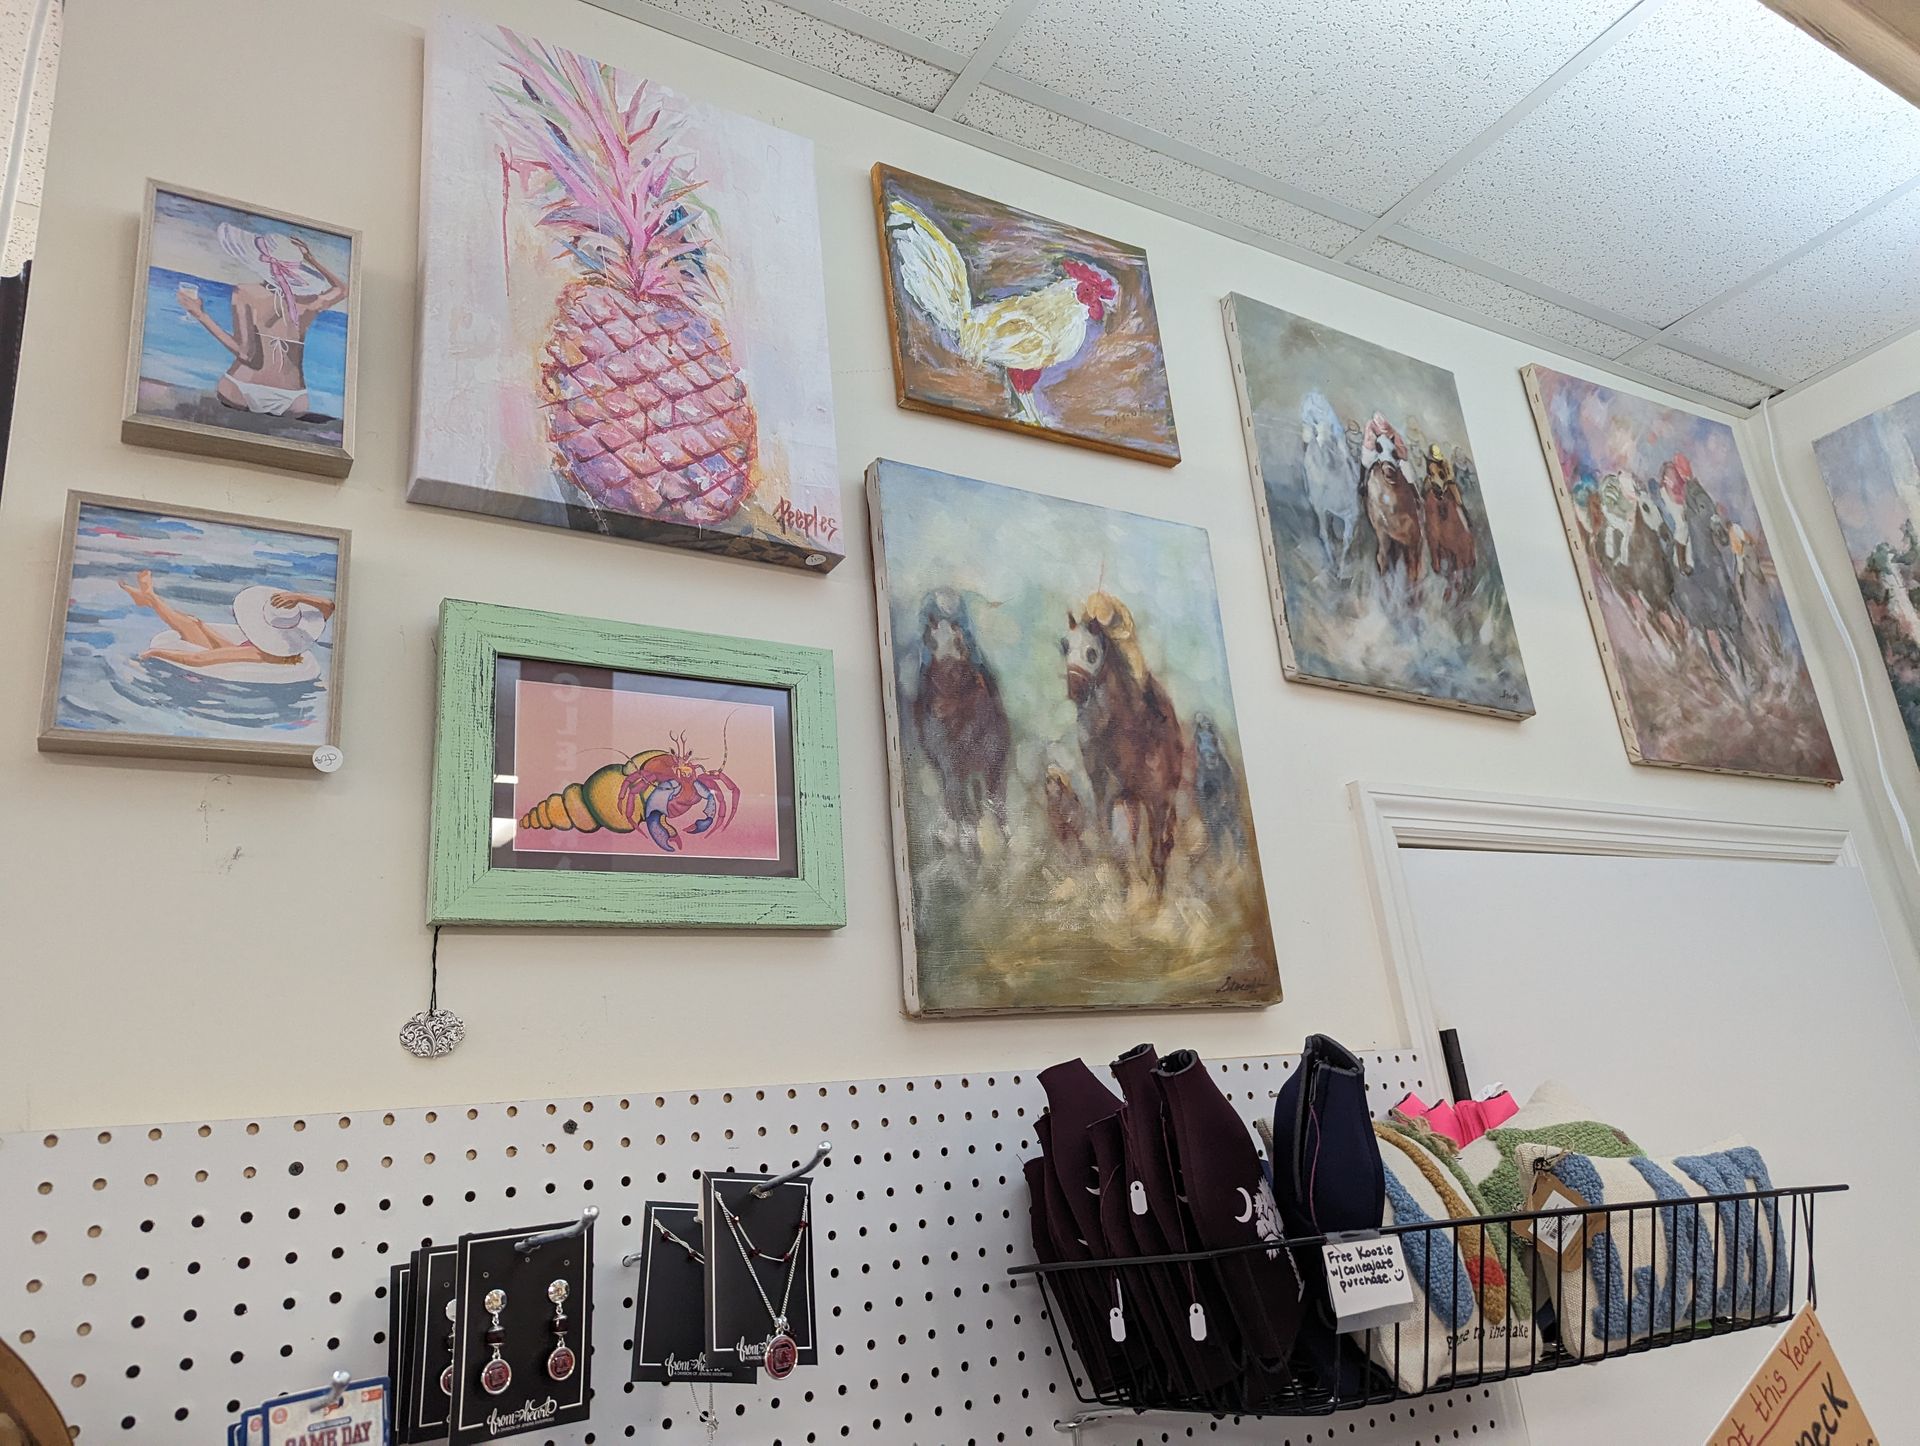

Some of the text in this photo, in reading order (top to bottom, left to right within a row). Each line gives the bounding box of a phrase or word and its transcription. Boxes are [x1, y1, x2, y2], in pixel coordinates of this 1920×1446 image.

[772, 496, 838, 541] Peeples
[1327, 1245, 1393, 1264] Free Koozie
[1510, 1324, 1529, 1339] ake
[1713, 1313, 1820, 1446] ot this Year!
[487, 1396, 558, 1436] from heart
[341, 1421, 372, 1445] DAY
